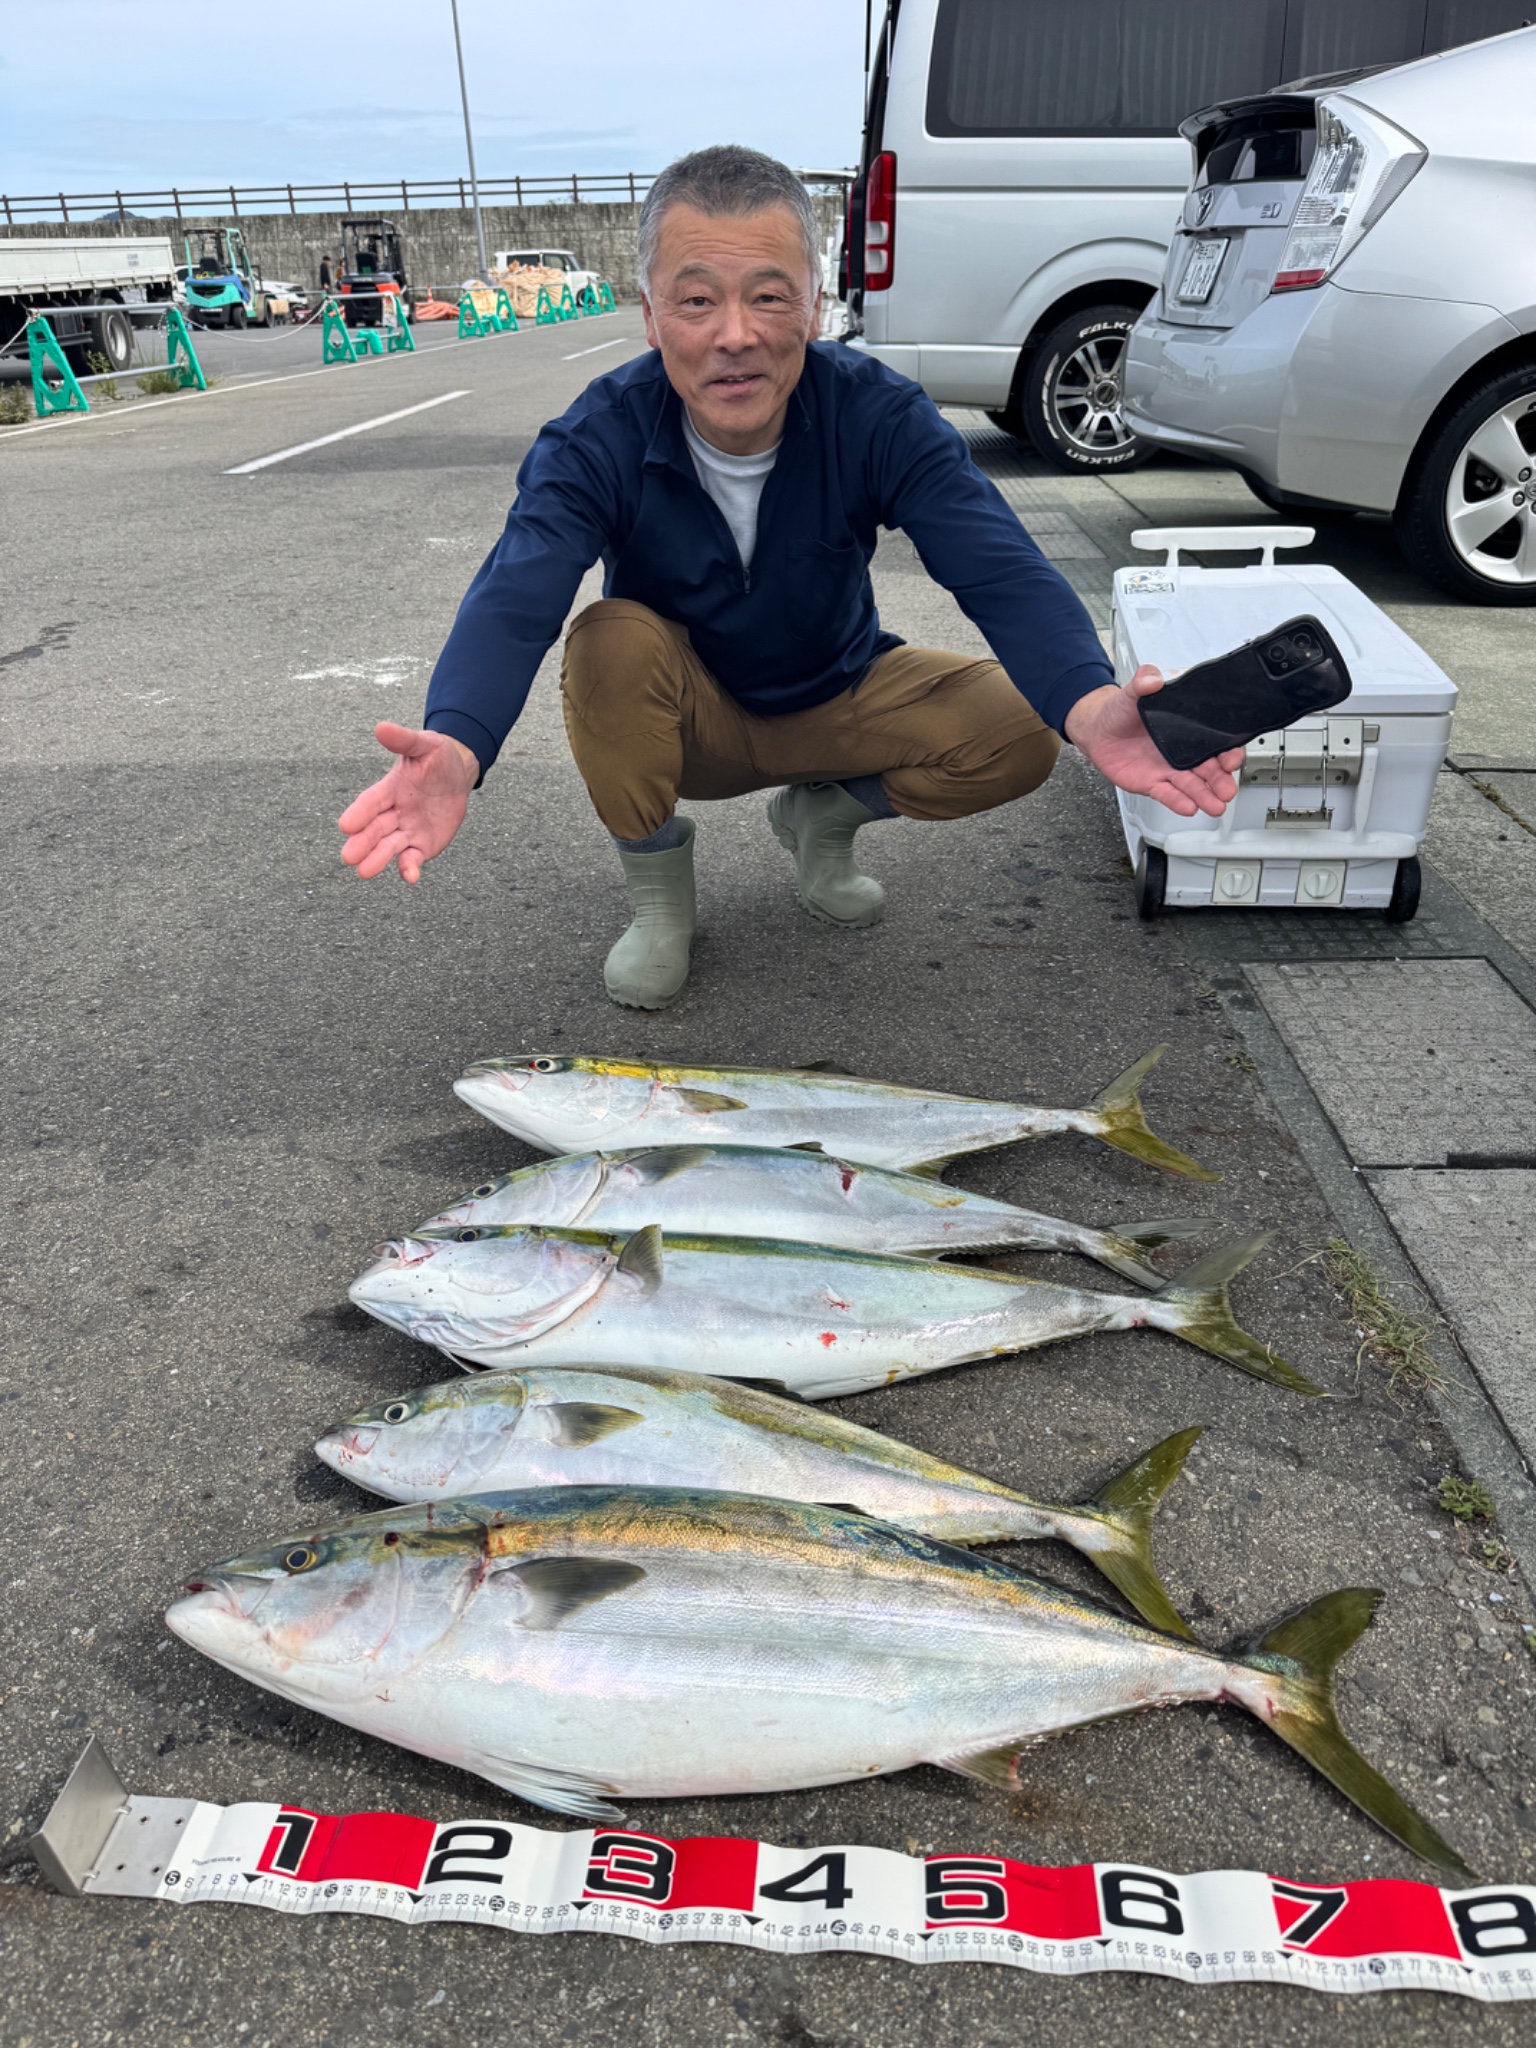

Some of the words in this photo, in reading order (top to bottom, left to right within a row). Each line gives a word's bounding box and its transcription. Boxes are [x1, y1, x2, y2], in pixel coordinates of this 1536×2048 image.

[166, 1871, 181, 1885] 5
[184, 1877, 195, 1888] 6
[200, 1875, 207, 1885] 7
[212, 1874, 222, 1885] 8
[228, 1874, 238, 1885] 9
[263, 1879, 274, 1890] 11
[279, 1883, 291, 1895] 12
[295, 1887, 307, 1898] 13
[324, 1884, 338, 1897] 15
[342, 1885, 353, 1896] 16
[359, 1886, 370, 1897] 17
[376, 1888, 388, 1899] 18
[394, 1891, 405, 1903] 19
[424, 1895, 435, 1907] 21
[439, 1893, 452, 1905] 22
[455, 1894, 469, 1905] 23
[472, 1895, 486, 1906] 24
[489, 1895, 505, 1911] 25
[508, 1901, 521, 1914] 26
[525, 1905, 537, 1917] 27
[557, 1904, 569, 1916] 29
[591, 1904, 604, 1915] 31
[608, 1905, 622, 1918] 32
[626, 1908, 640, 1920] 33
[643, 1913, 656, 1925] 34
[658, 1914, 673, 1930] 35
[676, 1914, 688, 1925] 36
[693, 1912, 706, 1924] 37
[711, 1913, 723, 1925] 38
[728, 1915, 741, 1927] 39
[764, 1923, 776, 1935] 41
[781, 1925, 794, 1937] 42
[798, 1925, 811, 1936] 43
[815, 1923, 828, 1934] 44
[830, 1919, 847, 1936] 45
[850, 1923, 863, 1934] 46
[869, 1925, 881, 1936] 47
[886, 1928, 899, 1940] 48
[903, 1933, 916, 1946] 49
[938, 1933, 950, 1945] 51
[955, 1932, 968, 1944] 52
[973, 1932, 986, 1944] 53
[991, 1933, 1005, 1945] 54
[1007, 1934, 1023, 1952] 55
[1026, 1941, 1039, 1954] 56
[1044, 1944, 1056, 1957] 57
[1062, 1945, 1075, 1958] 58
[1117, 1941, 1129, 1953] 61
[1135, 1942, 1148, 1955] 62
[1153, 1945, 1166, 1958] 63
[1170, 1949, 1183, 1961] 64
[1185, 1951, 1202, 1969] 65
[1224, 1951, 1236, 1963] 67
[1298, 1956, 1310, 1969] 71
[1315, 1962, 1328, 1974] 72
[1332, 1963, 1347, 1975] 73
[1350, 1964, 1366, 1975] 74
[1368, 1958, 1386, 1975] 75
[1389, 1959, 1403, 1971] 76
[1408, 1959, 1421, 1971] 77
[1427, 1960, 1441, 1973] 78
[275, 1814, 315, 1872] 1
[424, 1826, 513, 1884] 2
[585, 1835, 674, 1901] 3
[759, 1852, 853, 1909] 4
[925, 1861, 1006, 1919] 5
[1101, 1871, 1184, 1935] 6
[1271, 1882, 1346, 1945] 7
[1450, 1894, 1536, 1957] 8
